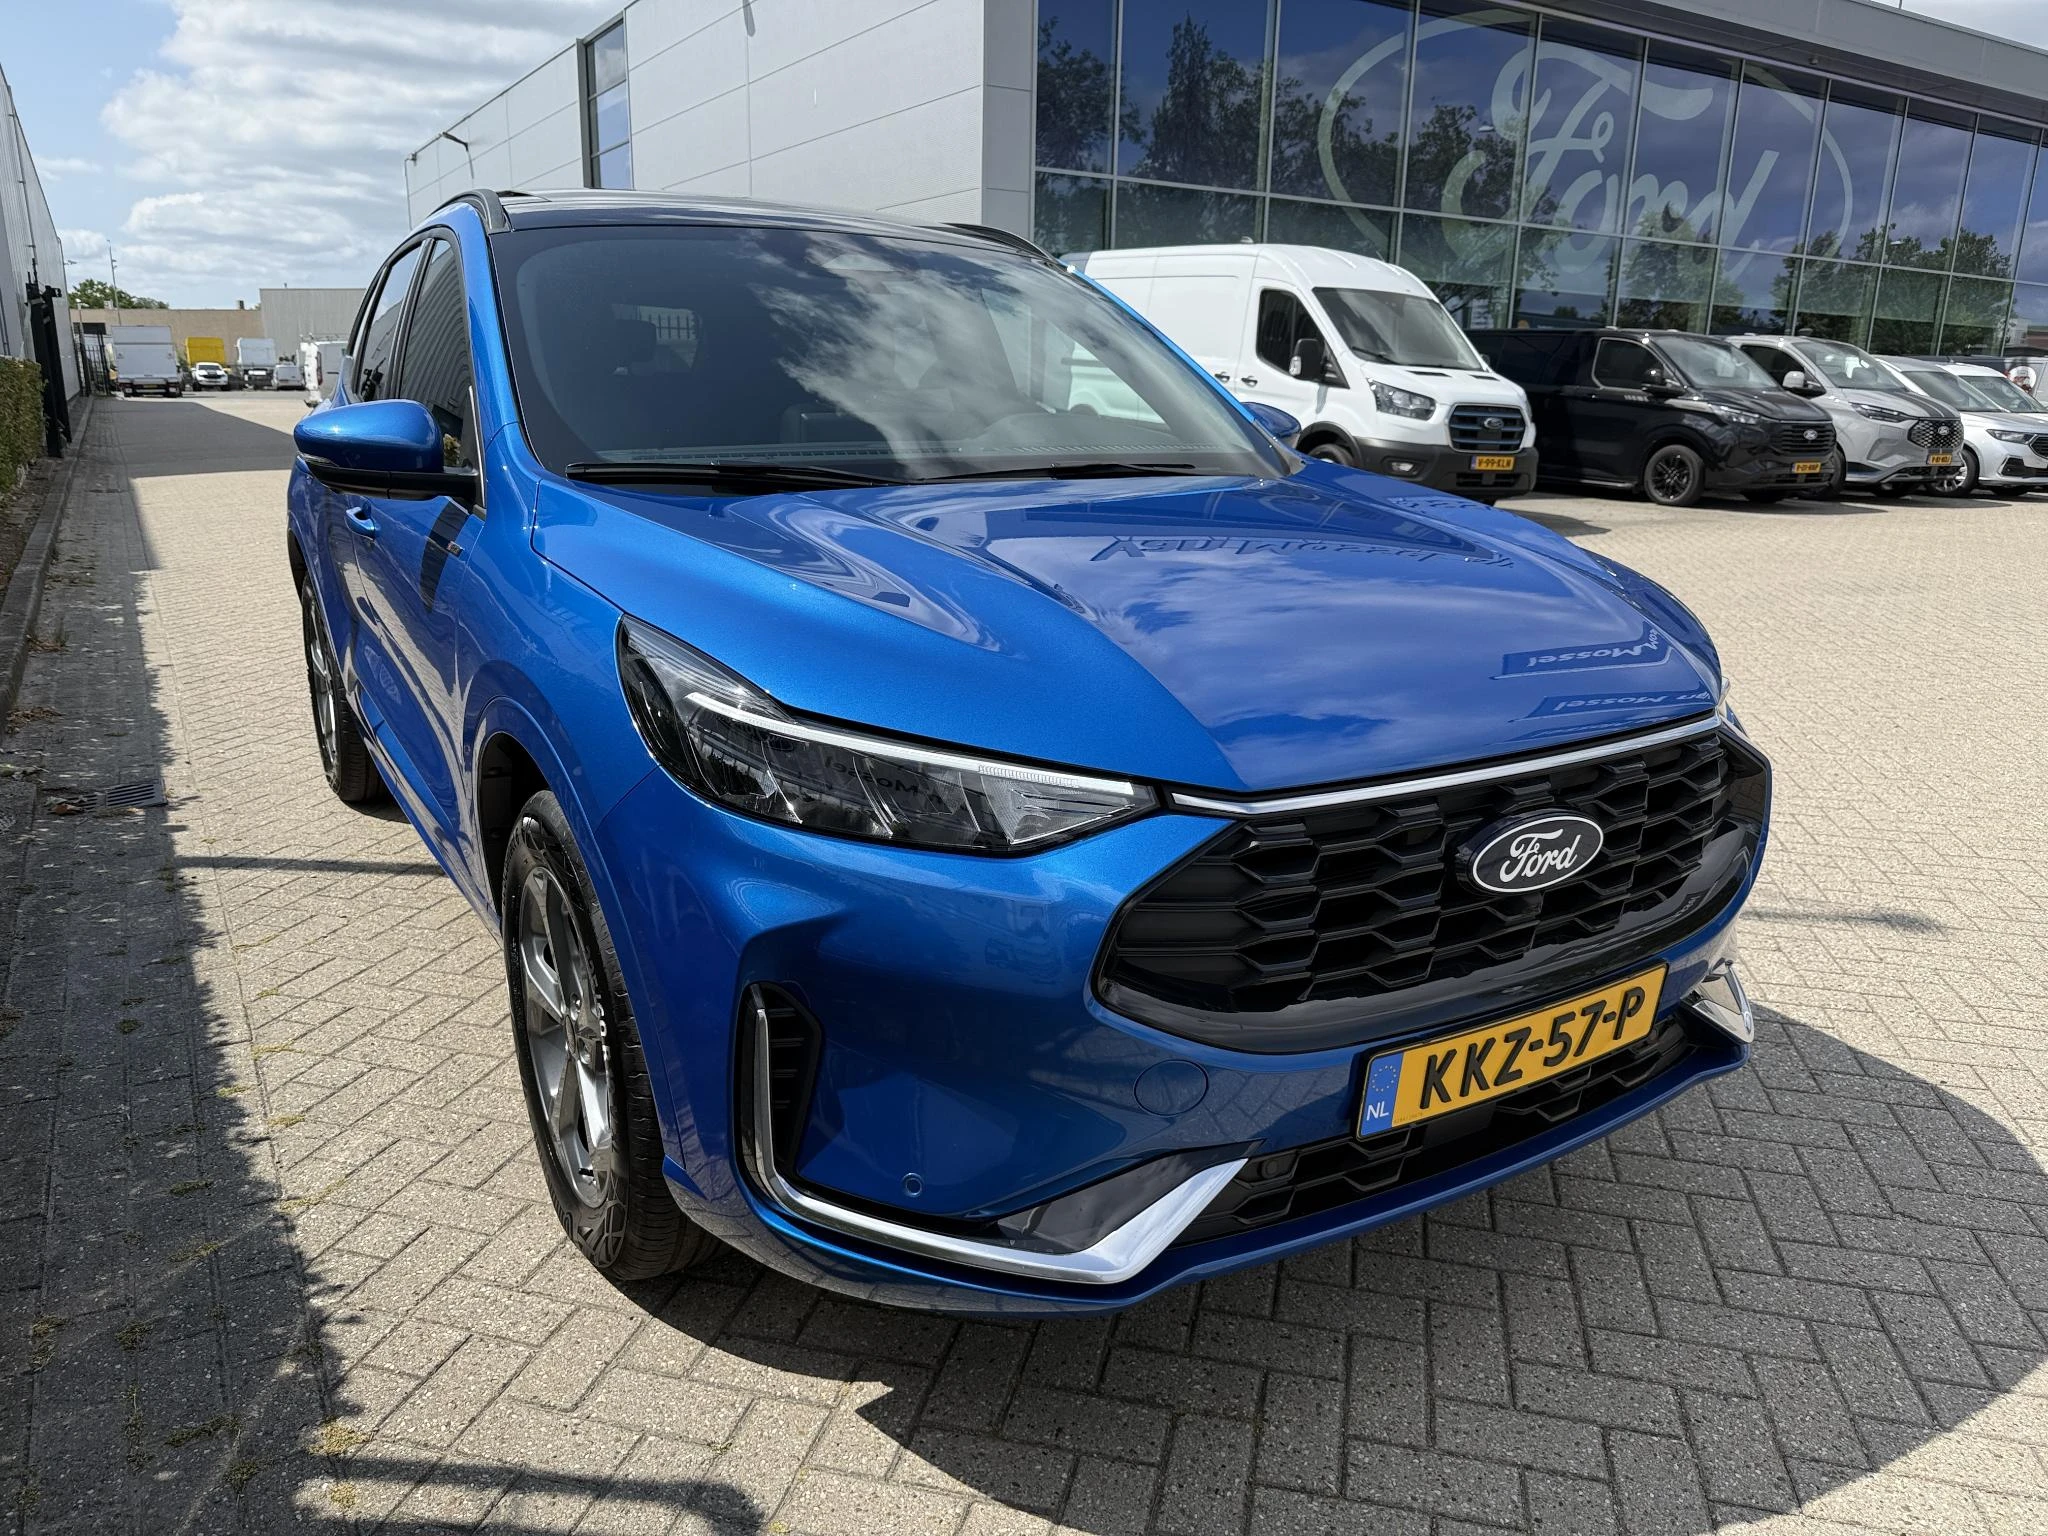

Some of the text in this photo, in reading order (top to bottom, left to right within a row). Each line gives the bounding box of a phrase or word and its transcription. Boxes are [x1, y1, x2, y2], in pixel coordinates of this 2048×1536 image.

[1441, 42, 1780, 281] Ford
[1499, 828, 1582, 883] Ford
[1419, 986, 1646, 1110] KKZ-57-P
[1366, 1101, 1389, 1121] NL
